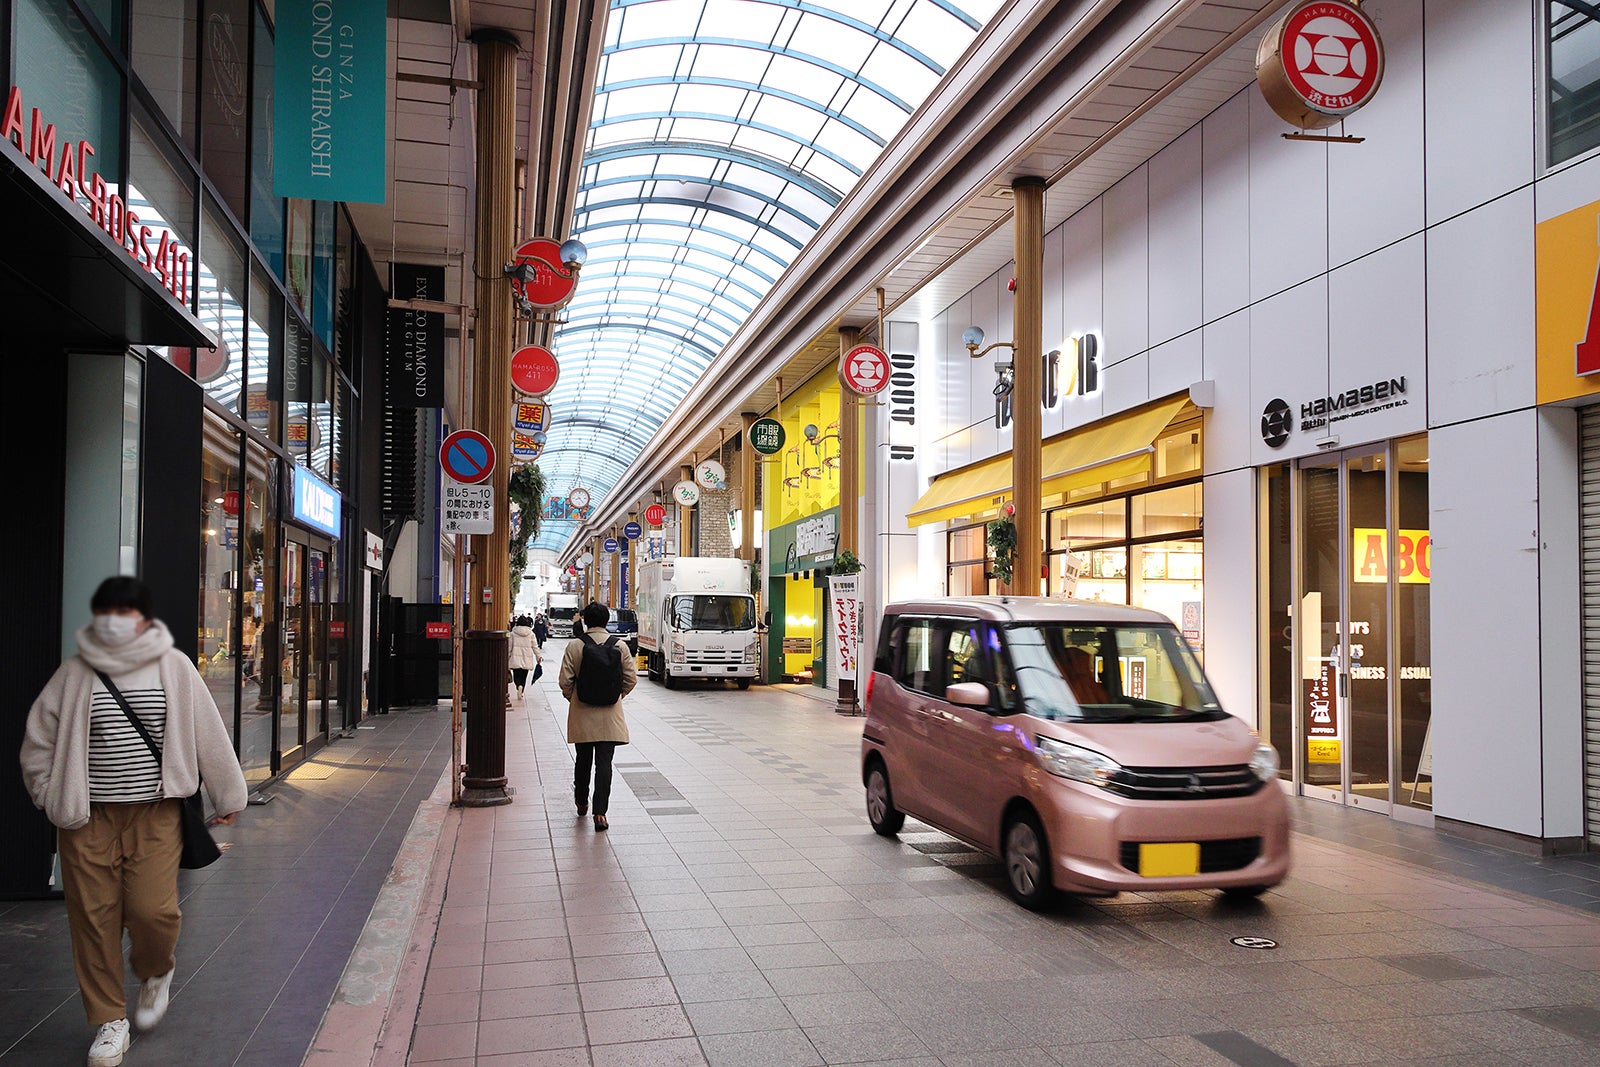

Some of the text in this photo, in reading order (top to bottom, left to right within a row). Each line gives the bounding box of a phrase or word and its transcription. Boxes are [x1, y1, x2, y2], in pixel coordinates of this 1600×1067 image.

[1304, 7, 1357, 24] HAMASEN
[339, 25, 354, 100] GINZA
[311, 0, 332, 178] OND SHIRAISHI
[415, 332, 427, 397] DIAMOND
[526, 372, 541, 380] 411
[446, 499, 490, 509] の間における
